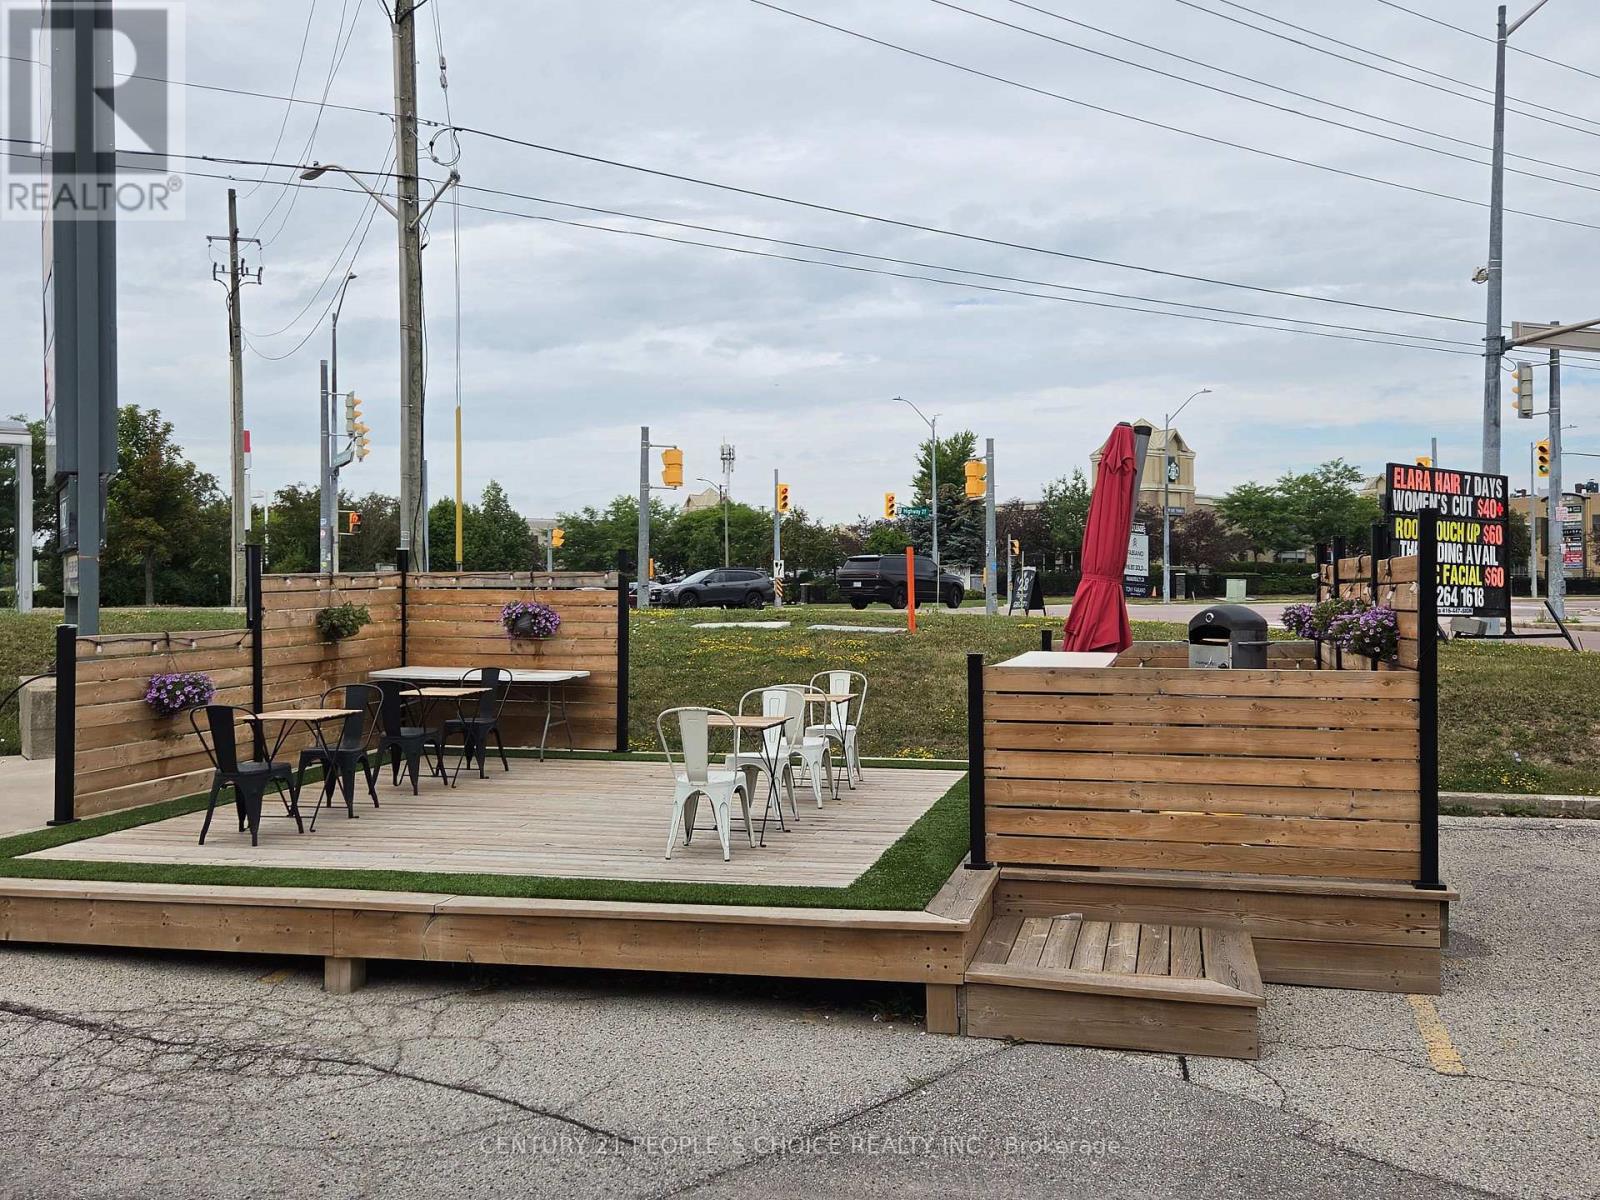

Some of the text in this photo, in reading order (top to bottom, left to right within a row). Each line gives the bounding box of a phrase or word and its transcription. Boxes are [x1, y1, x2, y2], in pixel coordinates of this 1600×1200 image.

[1393, 466, 1503, 498] ELARA HAIR 7 DAYS
[1452, 495, 1474, 517] CUT
[1436, 520, 1465, 543] OUCH
[1466, 522, 1481, 543] UP
[1483, 524, 1503, 545] $60
[1465, 544, 1499, 566] AVAIL
[1442, 564, 1483, 586] FACIAL
[1485, 566, 1505, 588] $60
[1436, 585, 1485, 607] 264 1618
